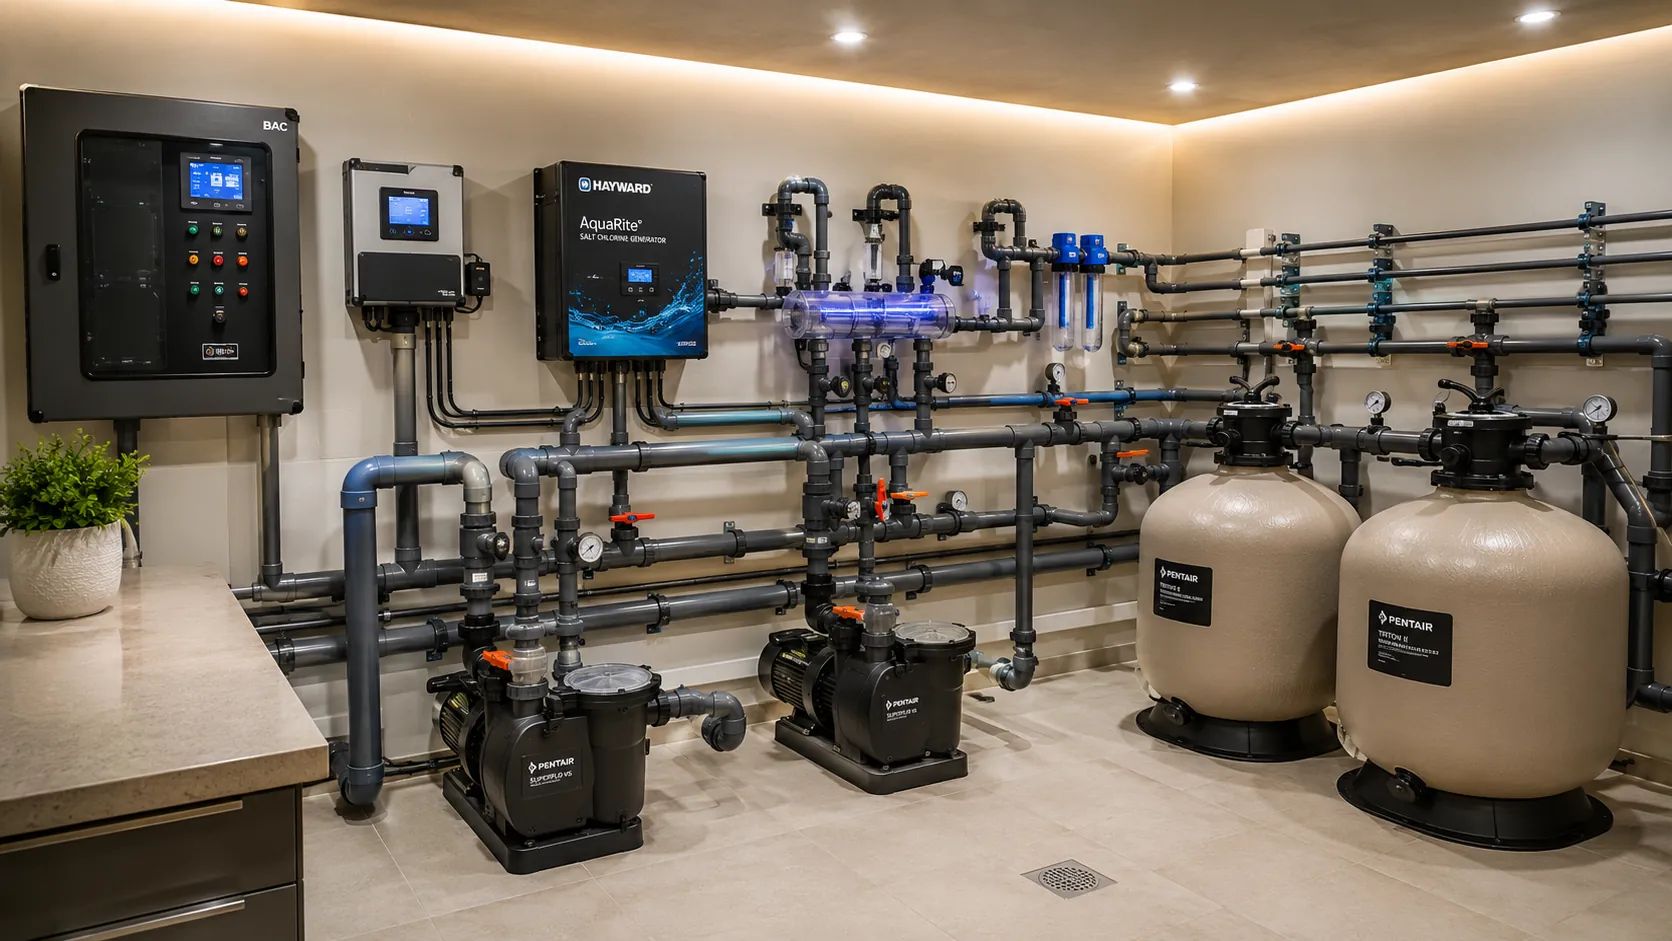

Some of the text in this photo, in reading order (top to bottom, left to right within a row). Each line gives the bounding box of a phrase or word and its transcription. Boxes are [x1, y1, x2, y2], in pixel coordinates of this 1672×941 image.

[263, 120, 288, 132] BAC
[592, 180, 653, 194] HAYWARD
[580, 233, 596, 241] SALT
[1388, 615, 1433, 632] PENTAIR
[538, 757, 575, 770] PENTAIR
